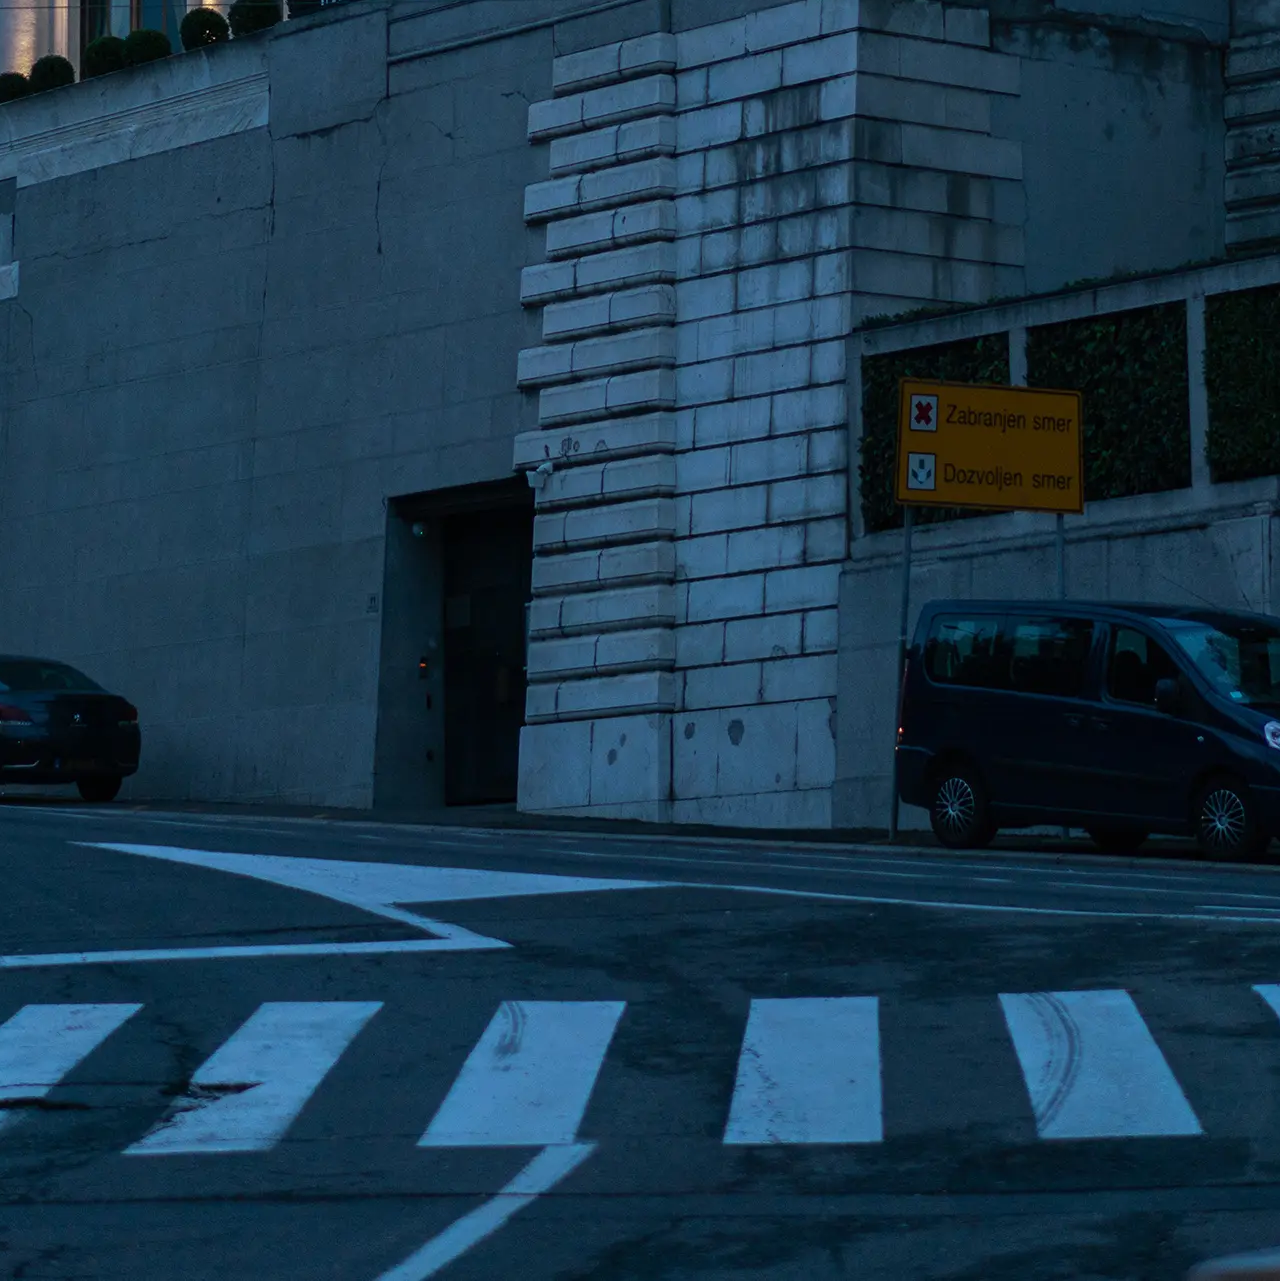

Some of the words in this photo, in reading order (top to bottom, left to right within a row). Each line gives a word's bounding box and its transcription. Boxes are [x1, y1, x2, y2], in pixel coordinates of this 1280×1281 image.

[945, 404, 1027, 433] Zabranjen
[1032, 414, 1073, 433] smer
[943, 462, 1024, 492] Dozvoljen
[1031, 472, 1073, 491] smer
